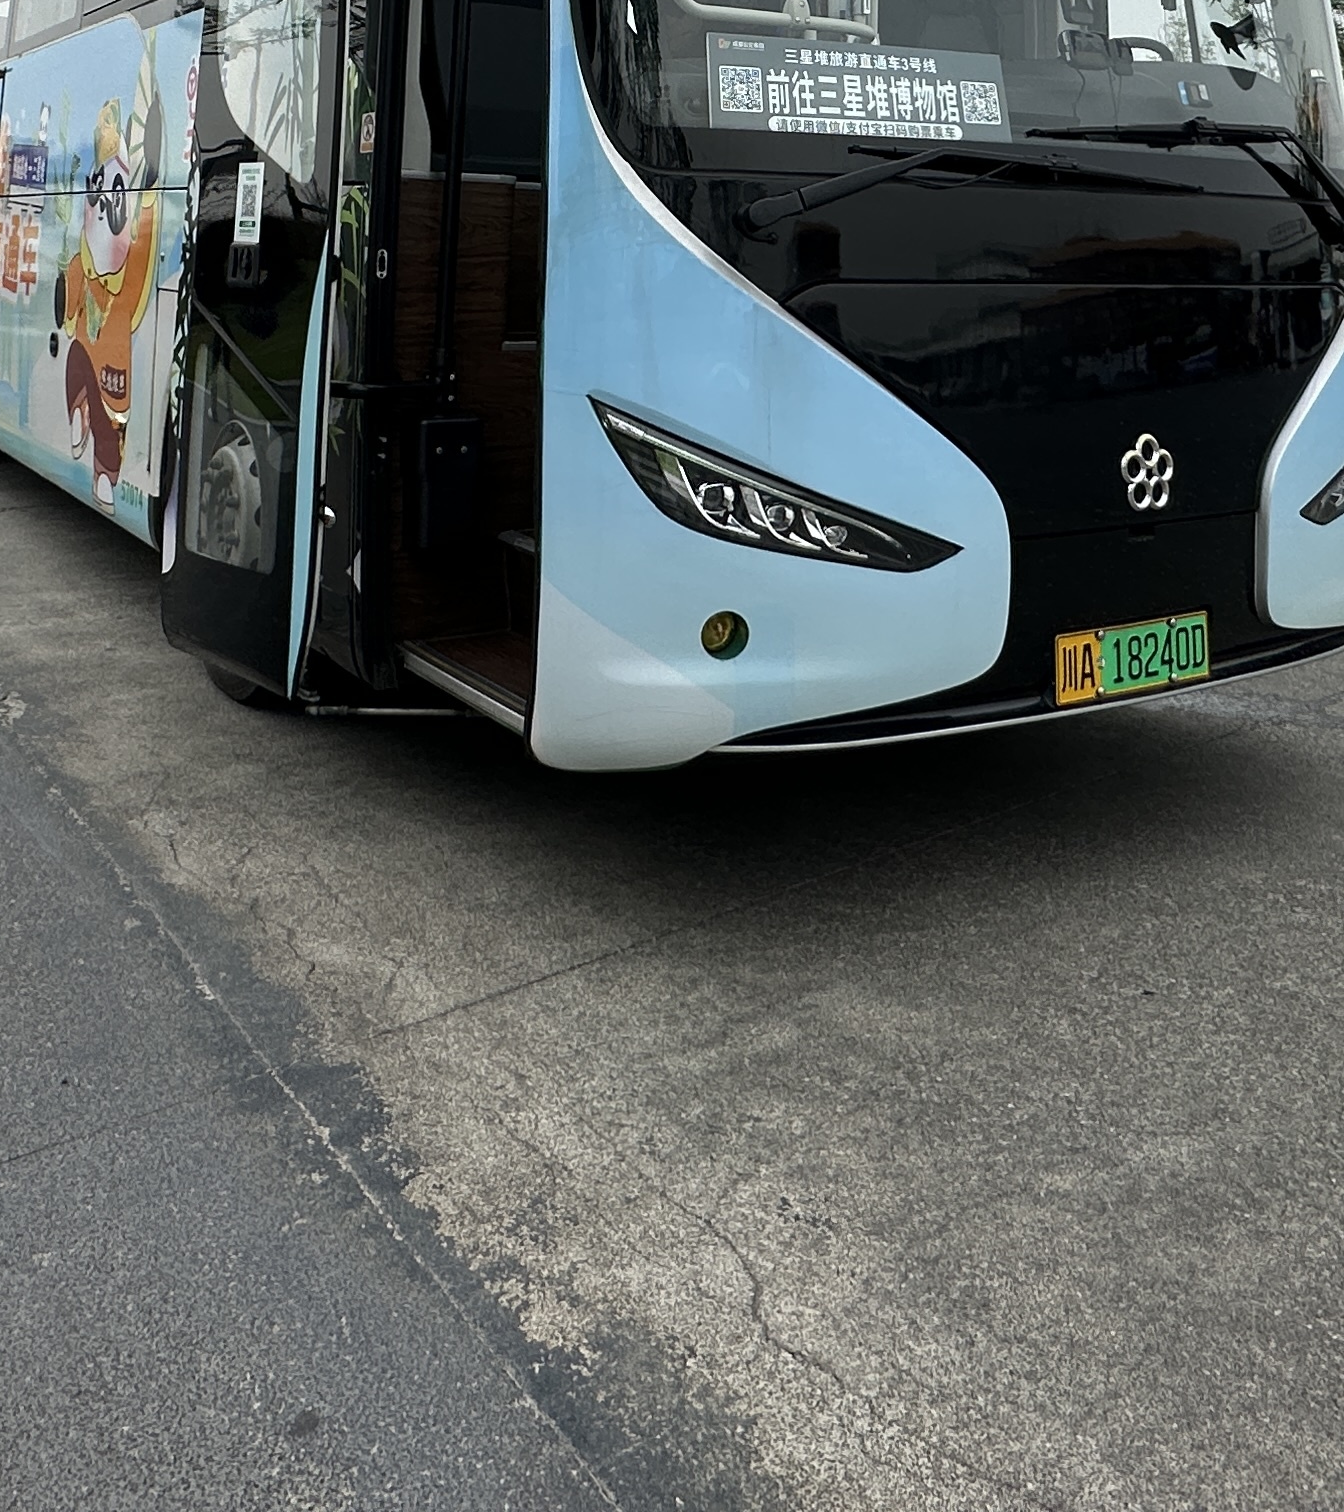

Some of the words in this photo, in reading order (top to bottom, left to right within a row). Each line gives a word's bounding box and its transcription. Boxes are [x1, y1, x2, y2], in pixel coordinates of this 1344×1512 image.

[784, 49, 938, 74] 三星堆旅游直通车3号线
[766, 69, 961, 123] 前往三星堆博物馆
